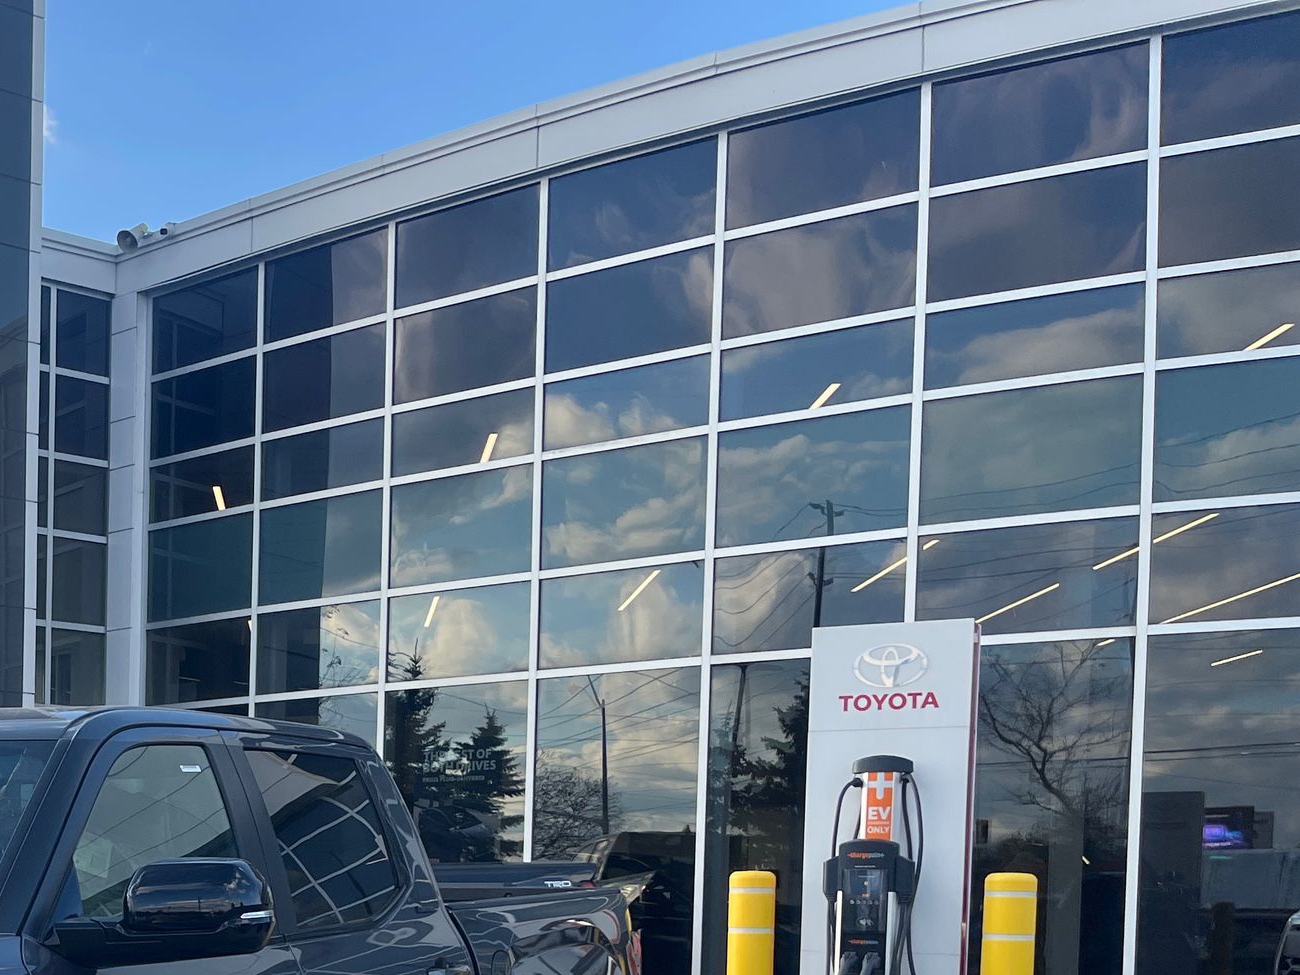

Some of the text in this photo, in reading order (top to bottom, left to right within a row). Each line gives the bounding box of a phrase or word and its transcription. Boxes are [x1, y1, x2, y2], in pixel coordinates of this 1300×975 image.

[838, 691, 940, 712] TOYOTA
[867, 806, 891, 821] EV
[866, 826, 890, 834] ONLY
